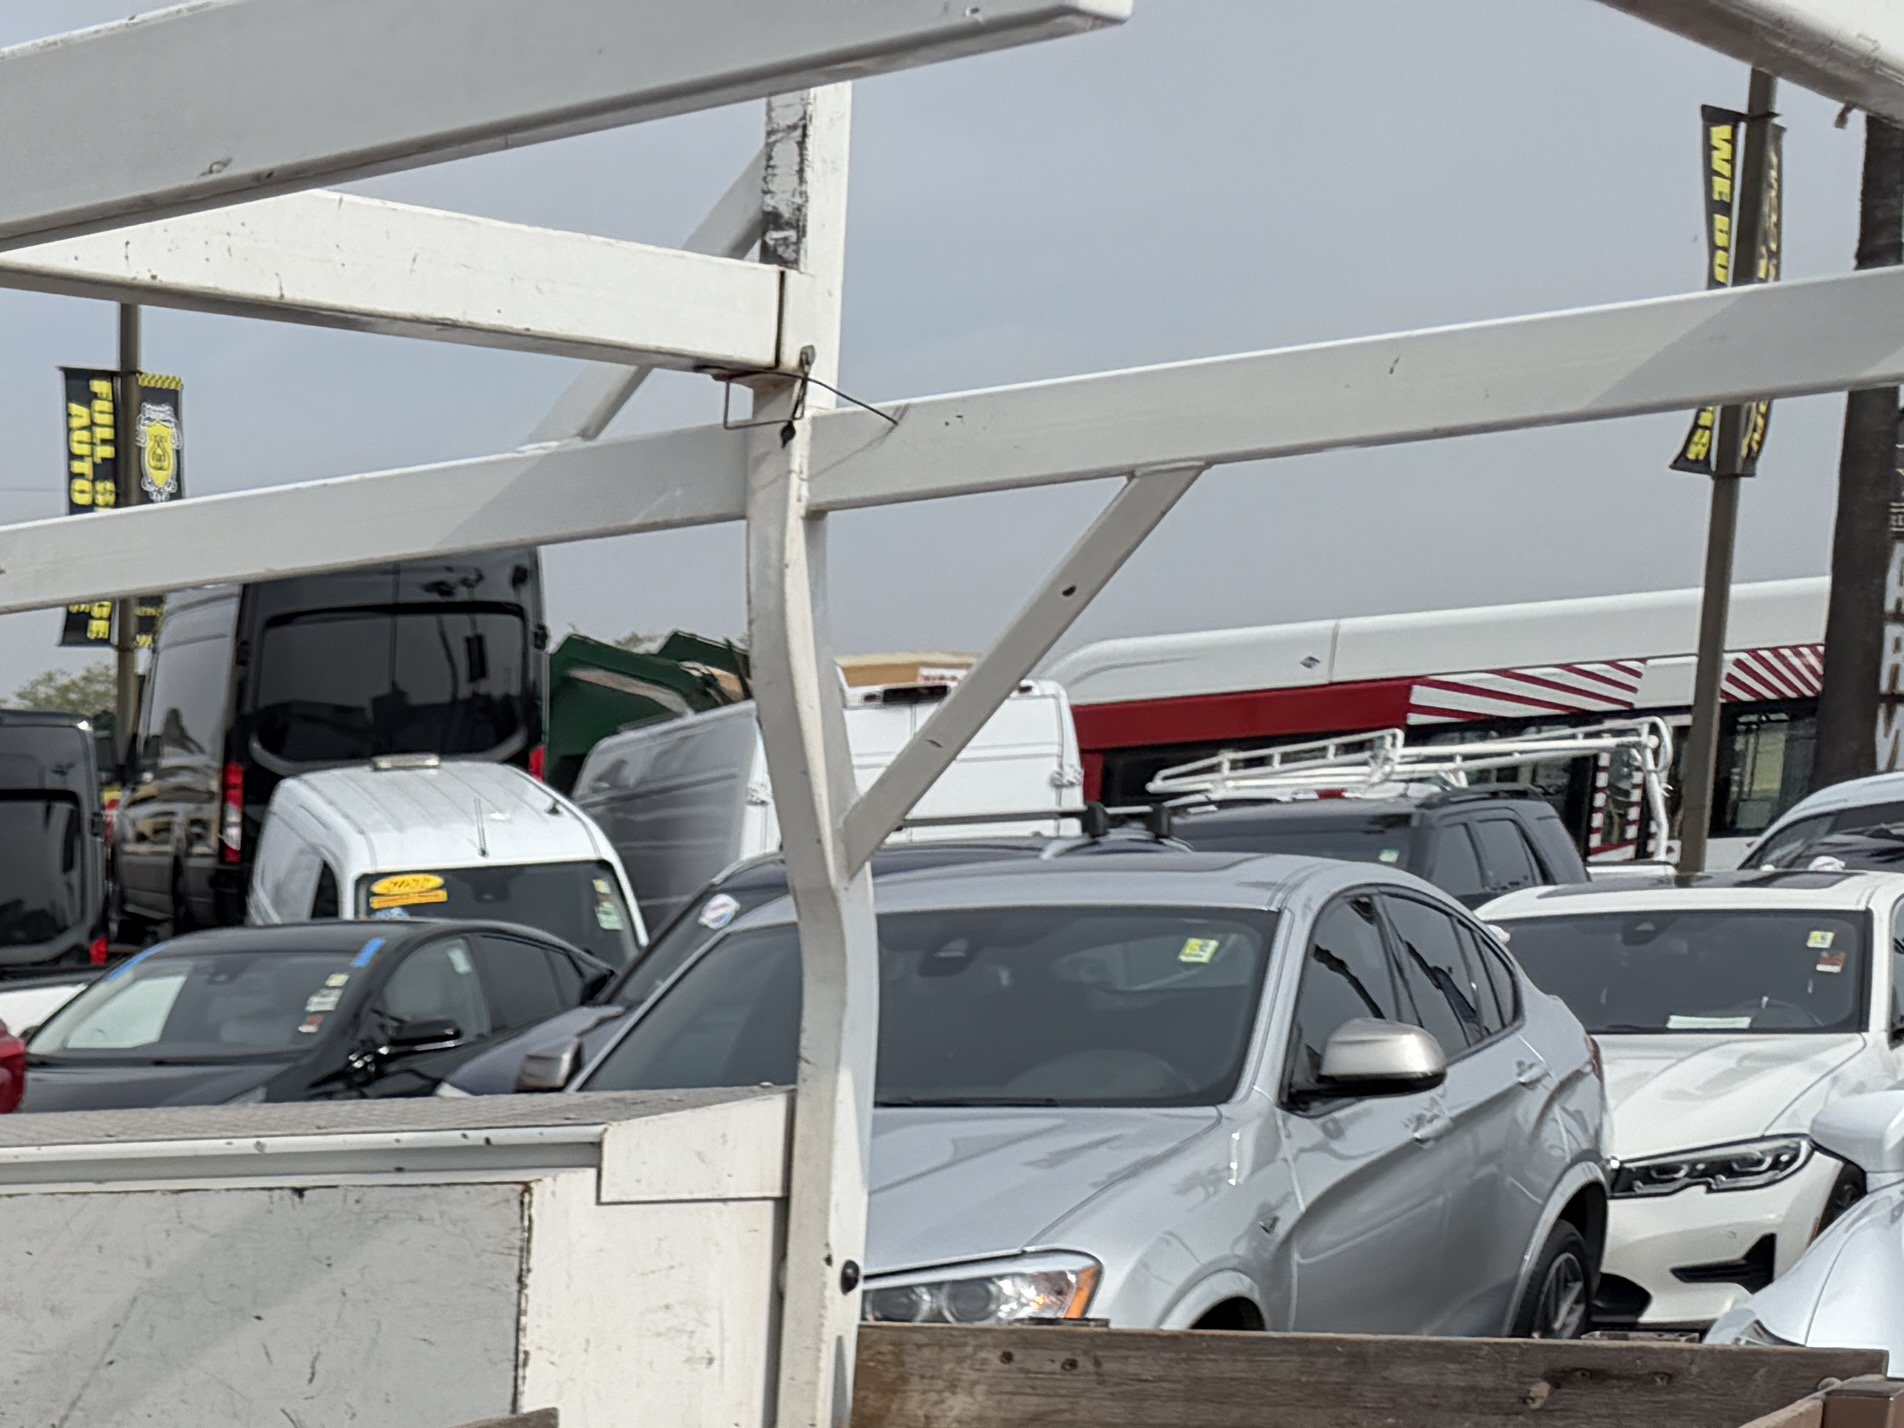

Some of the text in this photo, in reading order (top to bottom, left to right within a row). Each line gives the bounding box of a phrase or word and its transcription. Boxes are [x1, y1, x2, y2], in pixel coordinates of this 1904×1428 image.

[1709, 124, 1733, 203] WE
[67, 401, 94, 506] AUTO
[89, 378, 115, 464] FULL
